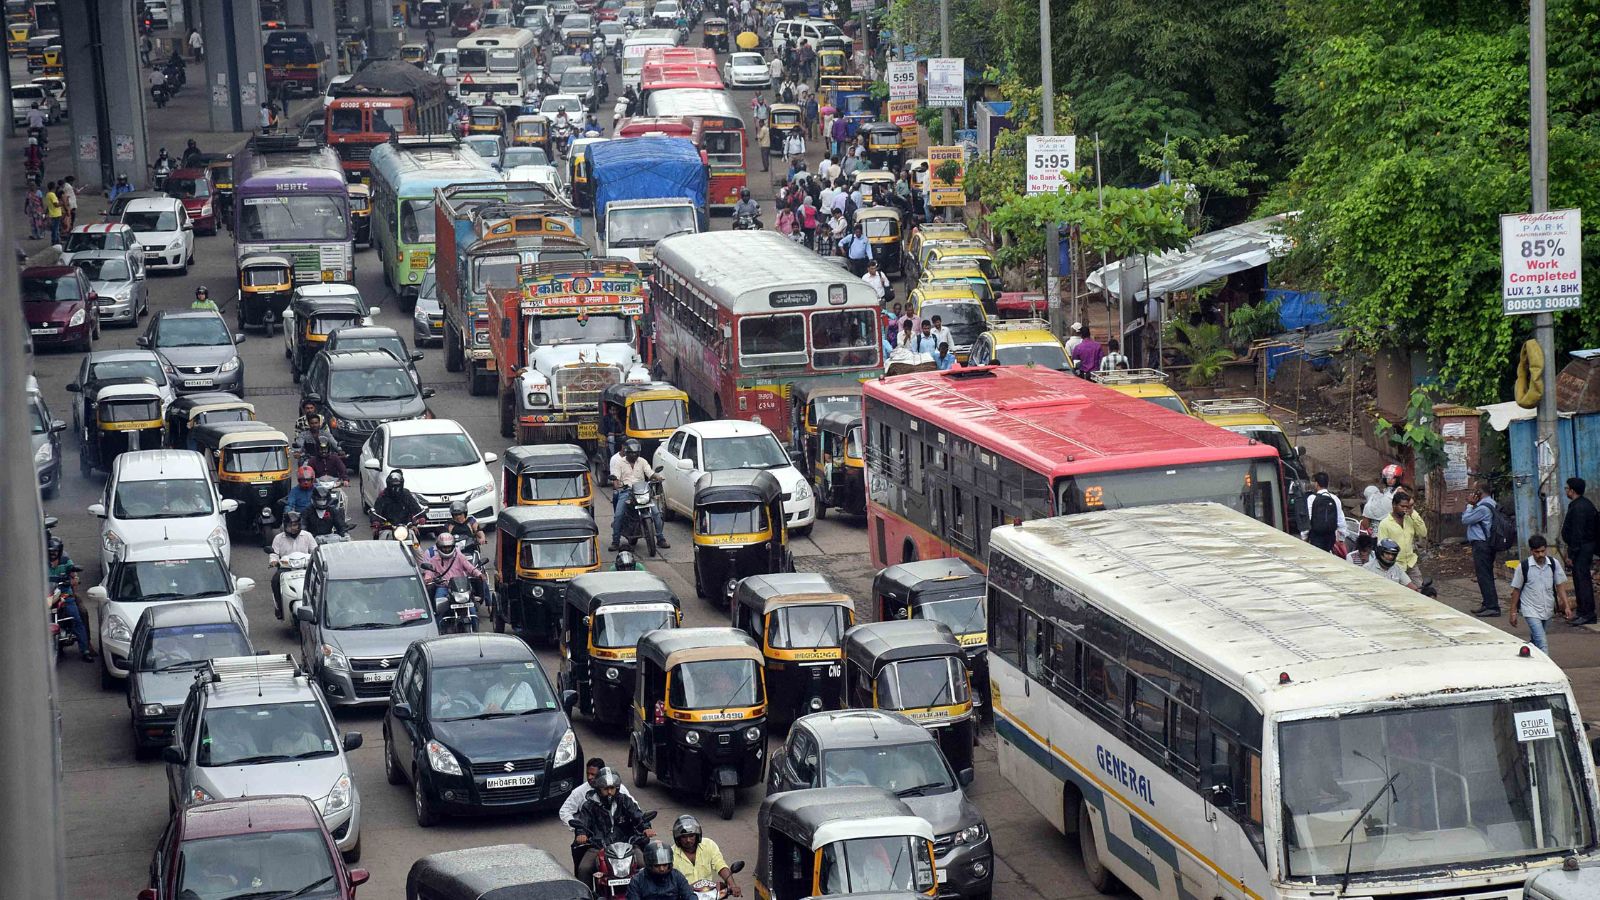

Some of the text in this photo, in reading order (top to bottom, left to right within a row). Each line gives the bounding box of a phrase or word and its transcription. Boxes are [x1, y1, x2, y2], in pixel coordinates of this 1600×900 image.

[894, 73, 914, 82] 5:95
[1034, 155, 1069, 168] 5:95
[1518, 213, 1567, 224] Highland
[1521, 239, 1565, 258] 85%
[1527, 260, 1558, 270] Work
[1510, 270, 1576, 283] Completed
[1507, 284, 1579, 296] LUX 2, 3 & 4 BHK
[1507, 297, 1580, 310] 80803 80803
[828, 665, 840, 677] CNG
[1523, 728, 1548, 736] POWAI
[1097, 744, 1155, 806] GENERAL
[488, 779, 517, 787] MH04FR
